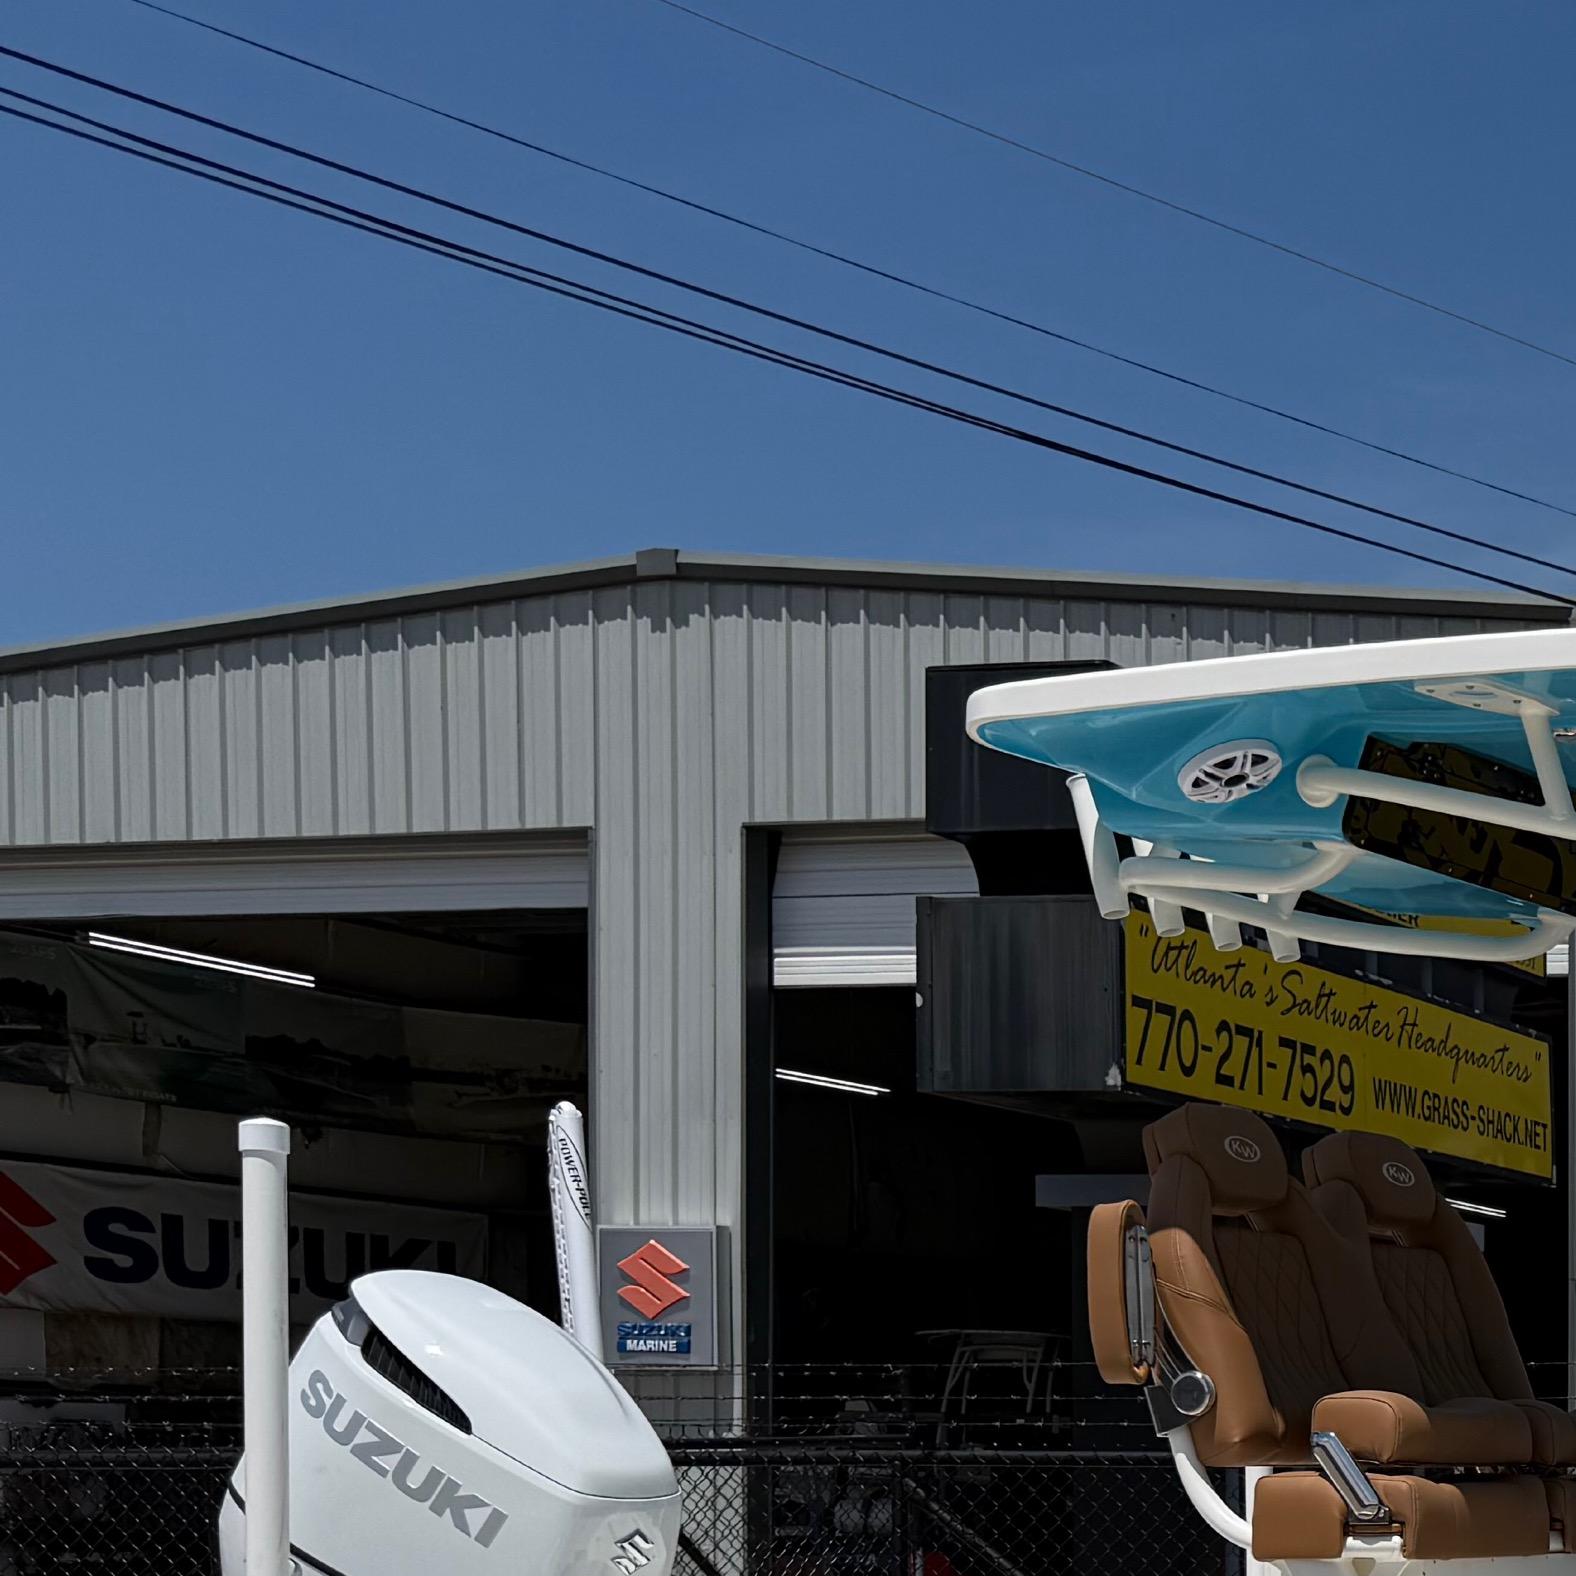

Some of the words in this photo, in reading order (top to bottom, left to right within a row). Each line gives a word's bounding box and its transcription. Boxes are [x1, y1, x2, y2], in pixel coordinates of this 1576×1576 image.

[1280, 969, 1394, 1042] Saltwater
[1131, 994, 1355, 1116] 770-271-7529
[1373, 1077, 1548, 1152] WWW.GRASS-SHACK.NET
[83, 1206, 456, 1300] SUUK
[626, 1339, 677, 1352] MARINE
[300, 1369, 510, 1549] SUZUKI
